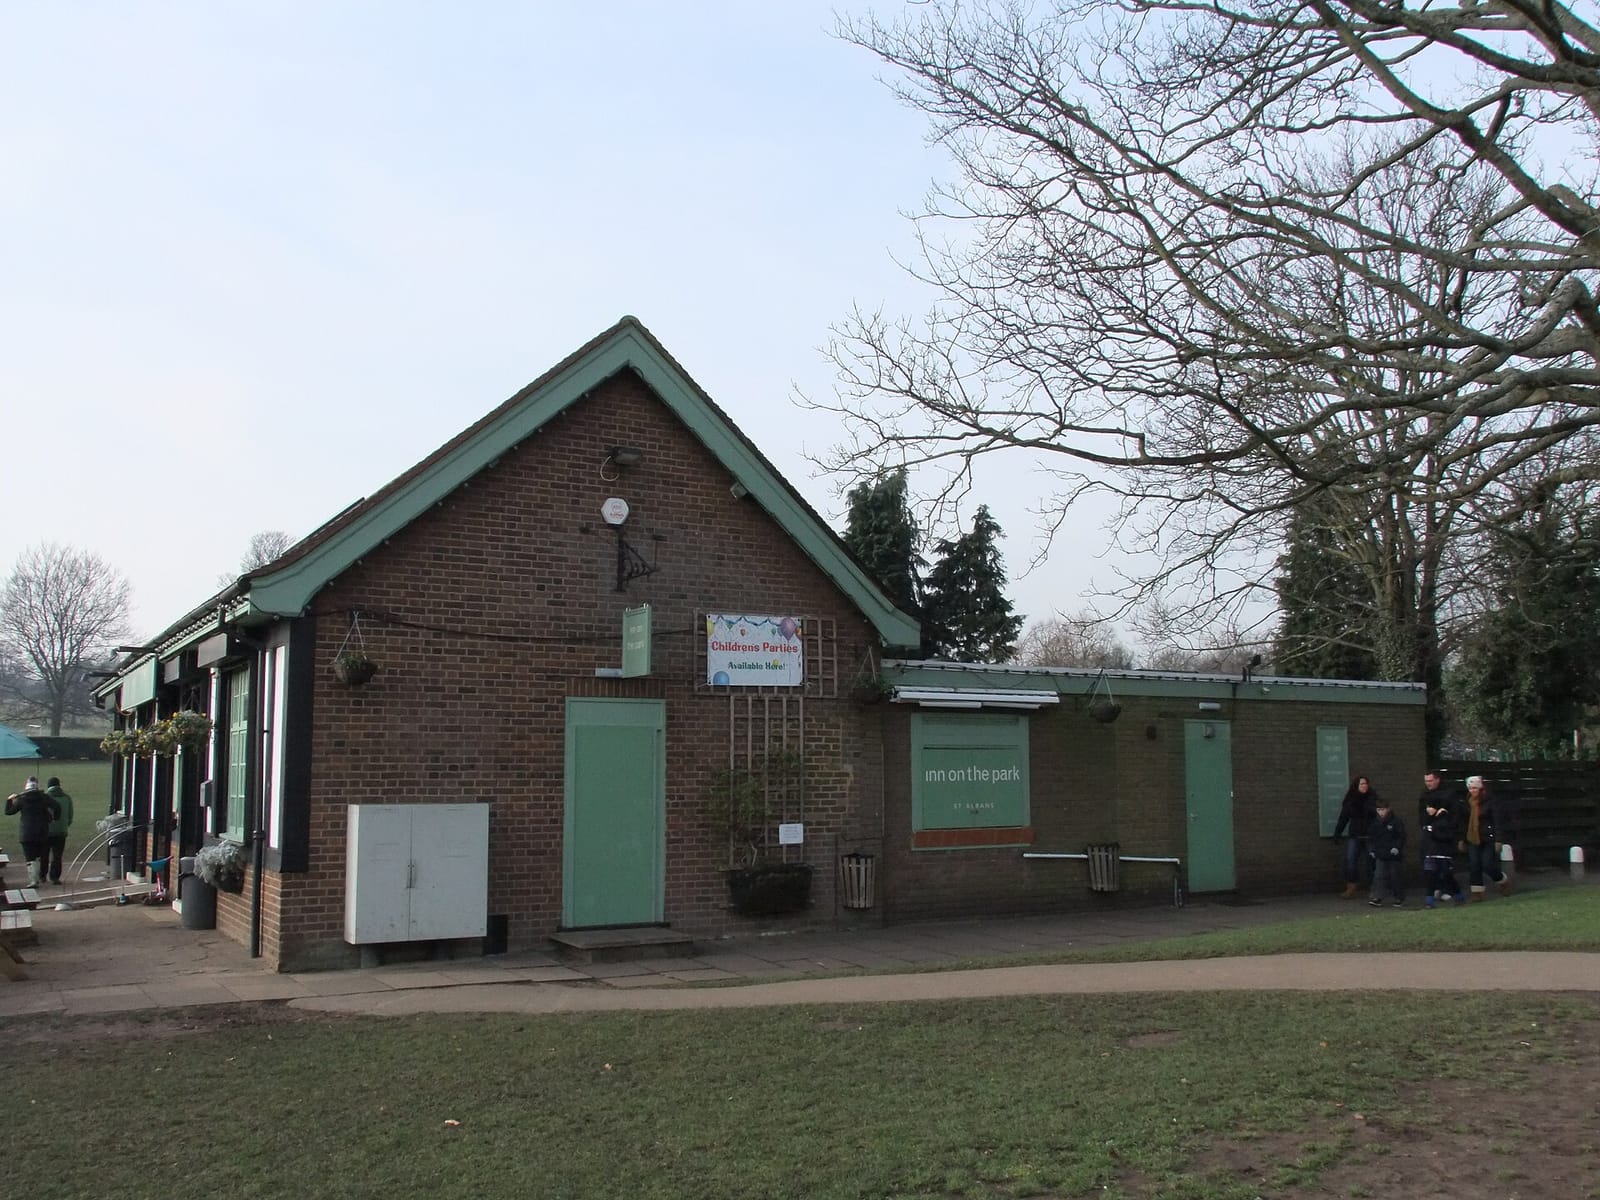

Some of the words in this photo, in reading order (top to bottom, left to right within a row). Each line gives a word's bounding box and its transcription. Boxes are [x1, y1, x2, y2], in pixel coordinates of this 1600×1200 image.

[711, 640, 760, 652] Childrens
[762, 641, 799, 653] Parties
[728, 661, 763, 670] Available
[925, 769, 945, 782] inn
[948, 769, 965, 782] on
[967, 765, 990, 782] the
[992, 765, 1020, 784] park
